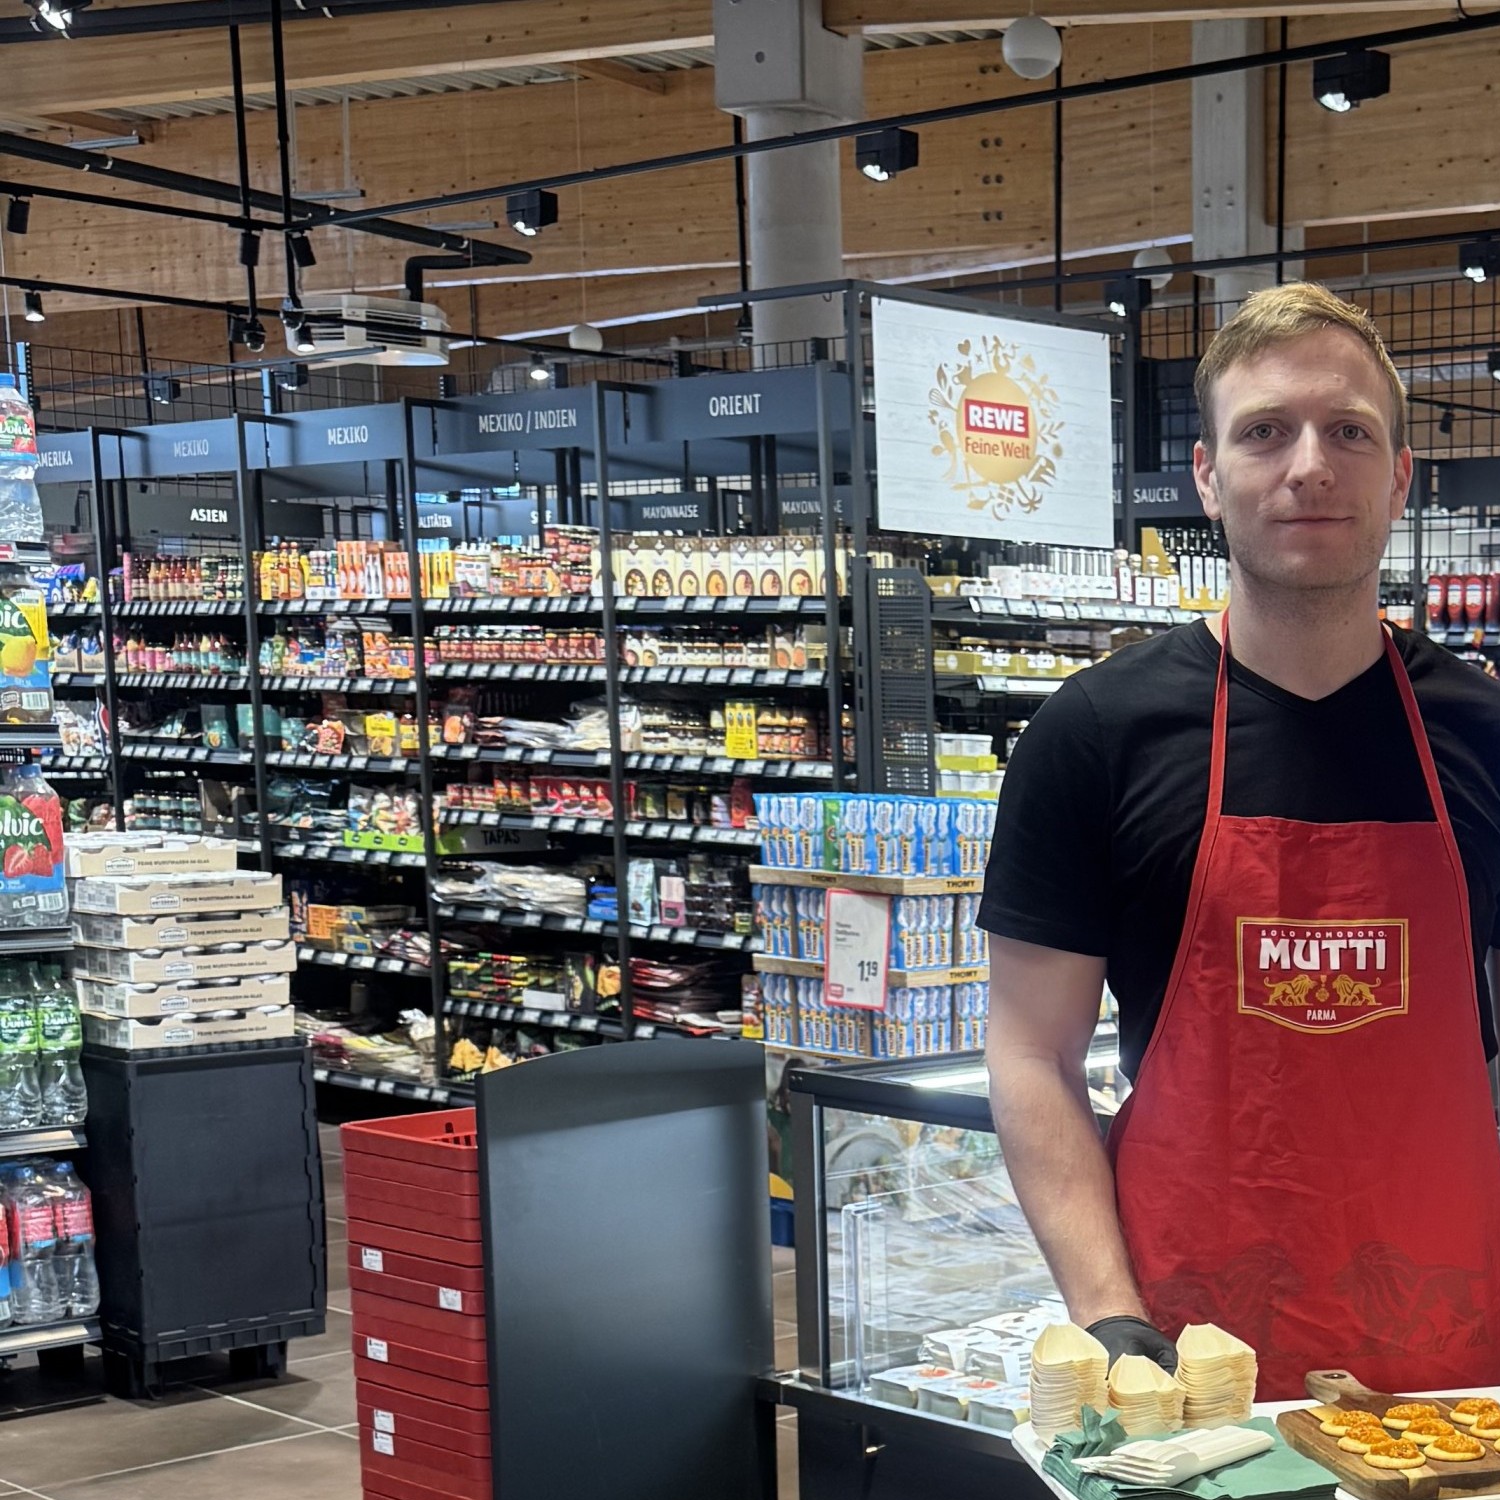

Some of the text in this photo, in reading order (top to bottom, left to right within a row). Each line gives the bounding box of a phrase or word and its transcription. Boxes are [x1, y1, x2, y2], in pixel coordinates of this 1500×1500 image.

[708, 393, 761, 416] ORIENT
[478, 411, 523, 433] MEXIKO
[534, 408, 577, 429] INDIEN
[968, 404, 1026, 433] REWE
[327, 426, 368, 446] MEXIKO
[173, 438, 209, 458] MEXIKO
[965, 436, 1031, 460] Feine Welt
[1133, 487, 1179, 503] SAUCEN
[190, 508, 228, 523] ASIEN
[642, 504, 699, 519] MAYONNAISE
[946, 880, 975, 888] THOMY
[1261, 929, 1296, 937] SOLO
[1259, 938, 1387, 970] MUTTI
[858, 960, 878, 982] 1.19
[949, 971, 978, 979] THOMY
[1306, 1009, 1336, 1021] PARMA
